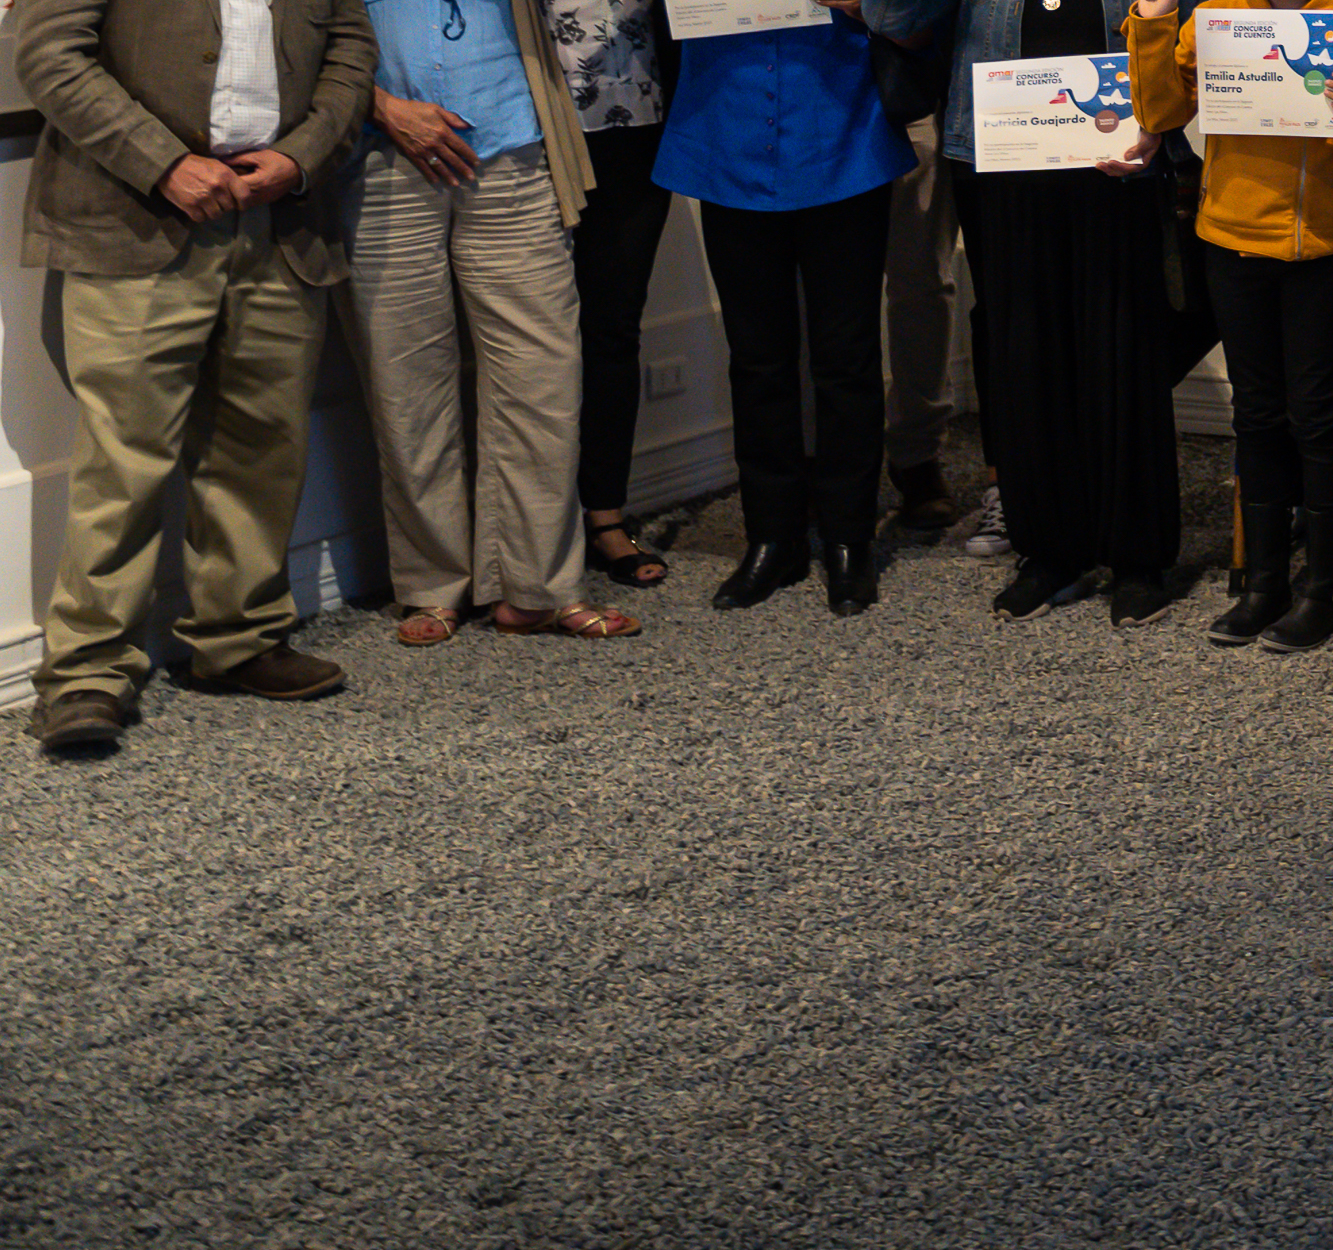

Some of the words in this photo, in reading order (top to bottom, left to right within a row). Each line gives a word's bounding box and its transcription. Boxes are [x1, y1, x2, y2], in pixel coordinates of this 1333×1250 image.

[988, 70, 1014, 78] amar
[1016, 72, 1060, 80] CONCURSO
[1205, 71, 1235, 81] Emilia
[1238, 72, 1283, 82] Astudillo
[1027, 77, 1062, 85] CUENTOS
[1205, 84, 1242, 93] Pizarro
[1030, 115, 1086, 127] Guajardo
